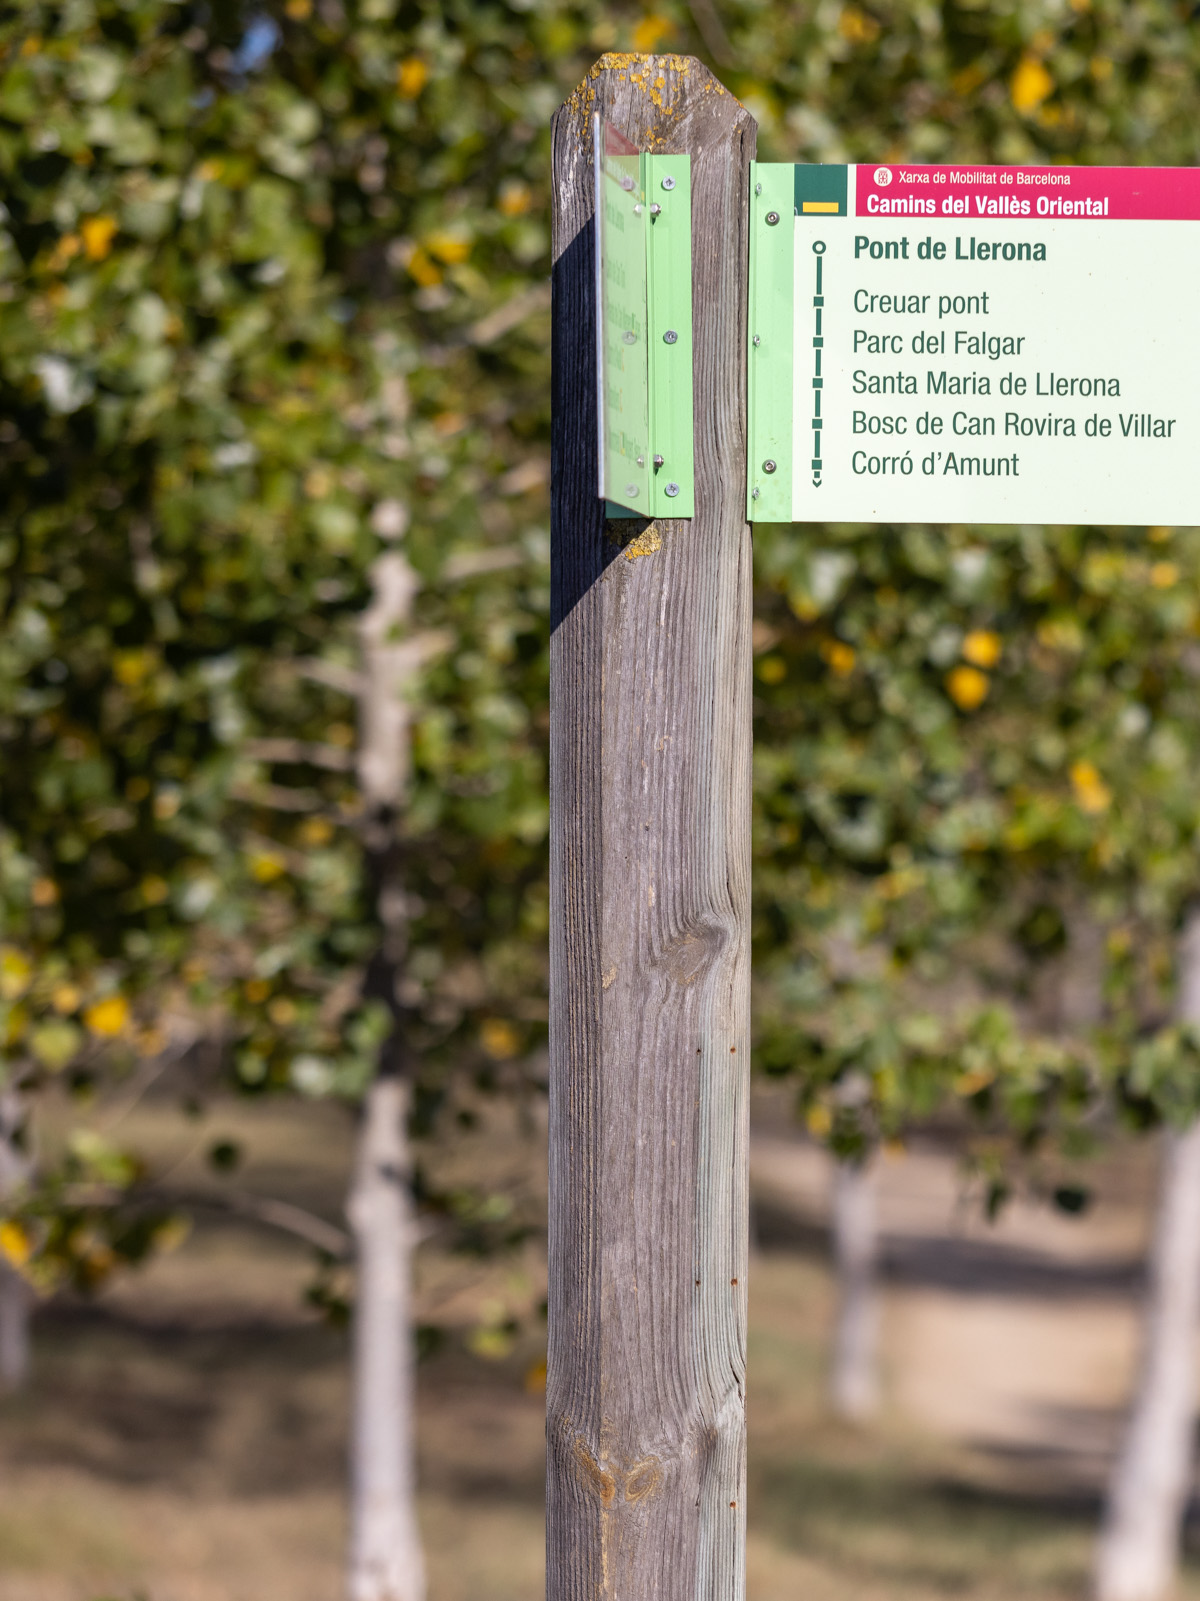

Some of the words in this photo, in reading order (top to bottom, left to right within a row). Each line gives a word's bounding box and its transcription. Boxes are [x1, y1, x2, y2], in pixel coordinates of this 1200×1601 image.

[899, 171, 929, 183] Xarxa
[933, 172, 946, 183] de
[950, 172, 996, 184] Mobilitat
[1000, 172, 1013, 184] de
[1017, 172, 1070, 185] Barcelona
[867, 194, 936, 213] Camins
[942, 196, 969, 214] del
[975, 195, 1030, 215] Vallès
[1037, 196, 1108, 215] Oriental
[855, 236, 909, 259] Pont
[917, 237, 946, 260] de
[956, 237, 1046, 261] Llerona
[854, 289, 930, 313] Creuar
[939, 292, 989, 319] pont
[854, 330, 903, 353] Parc
[912, 331, 944, 354] del
[955, 331, 1025, 360] Falgar
[853, 370, 918, 394] Santa
[927, 371, 991, 395] Maria
[1000, 372, 1026, 395] de
[1037, 373, 1120, 396] Llerona
[853, 411, 907, 434] Bosc
[916, 412, 943, 435] de
[953, 412, 995, 435] Can
[1005, 413, 1076, 436] Rovira
[1085, 414, 1111, 437] de
[1119, 414, 1176, 437] Villar
[852, 451, 913, 475] Corró
[922, 452, 1019, 476] d’Amunt
